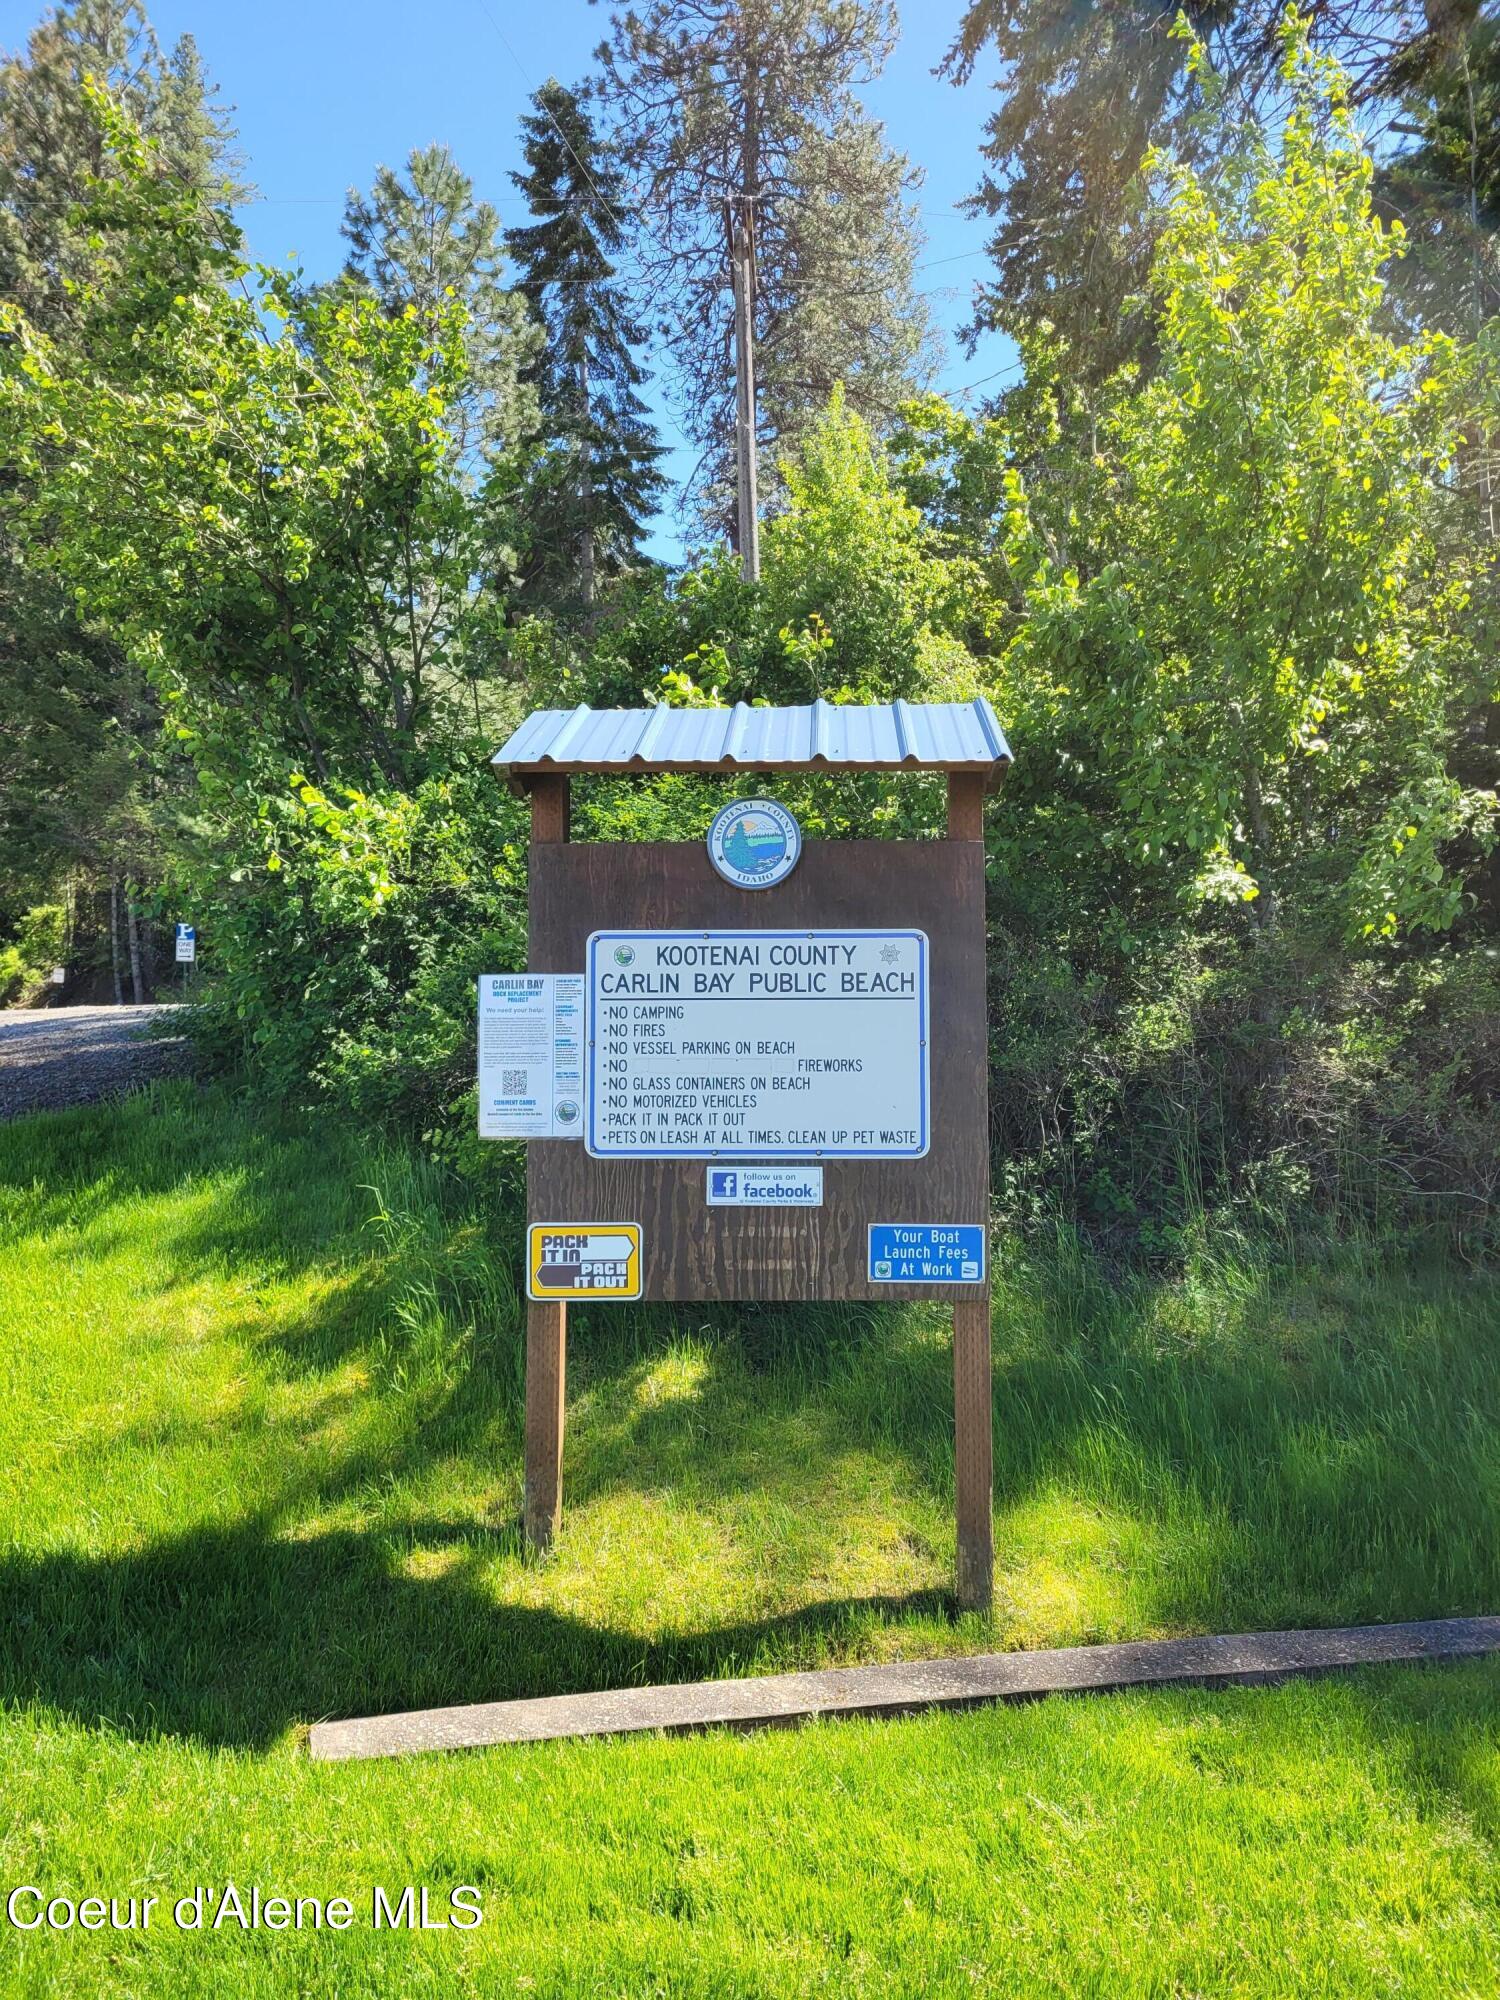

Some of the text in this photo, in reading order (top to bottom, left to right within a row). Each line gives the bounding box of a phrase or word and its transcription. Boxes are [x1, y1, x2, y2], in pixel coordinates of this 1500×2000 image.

[767, 805, 795, 840] COUNTY
[737, 873, 774, 882] IDAHO
[656, 945, 857, 966] KOOTENAI COUNTY
[492, 980, 544, 989] CARLIN BAY
[600, 973, 680, 994] CARLIN
[694, 973, 735, 993] BAY
[750, 972, 827, 993] PUBLIC
[841, 972, 915, 992] BEACH
[609, 1007, 684, 1019] NO CAMPING
[609, 1024, 665, 1037] NO FIRES
[609, 1042, 795, 1054] NO VESSEL PARKING ON BEACH
[609, 1059, 862, 1072] NO FIREWORKS
[609, 1077, 810, 1090] NO GLASS CONTAINERS ON BEACH
[609, 1095, 757, 1108] NO MOTORIZED VEHICLES
[608, 1113, 745, 1126] PACK IT IN PACK IT OUT
[608, 1131, 917, 1144] PETS ON LEASH AT ALL TIMES. CLEAN UP PET WASTE
[744, 1184, 812, 1197] facebook
[542, 1235, 588, 1248] PACK
[894, 1230, 959, 1243] Your Boat
[542, 1250, 580, 1262] IT IN
[884, 1245, 968, 1258] Launch Fees
[581, 1264, 626, 1274] PACK
[901, 1263, 952, 1275] At Work
[574, 1277, 626, 1288] IT OUT
